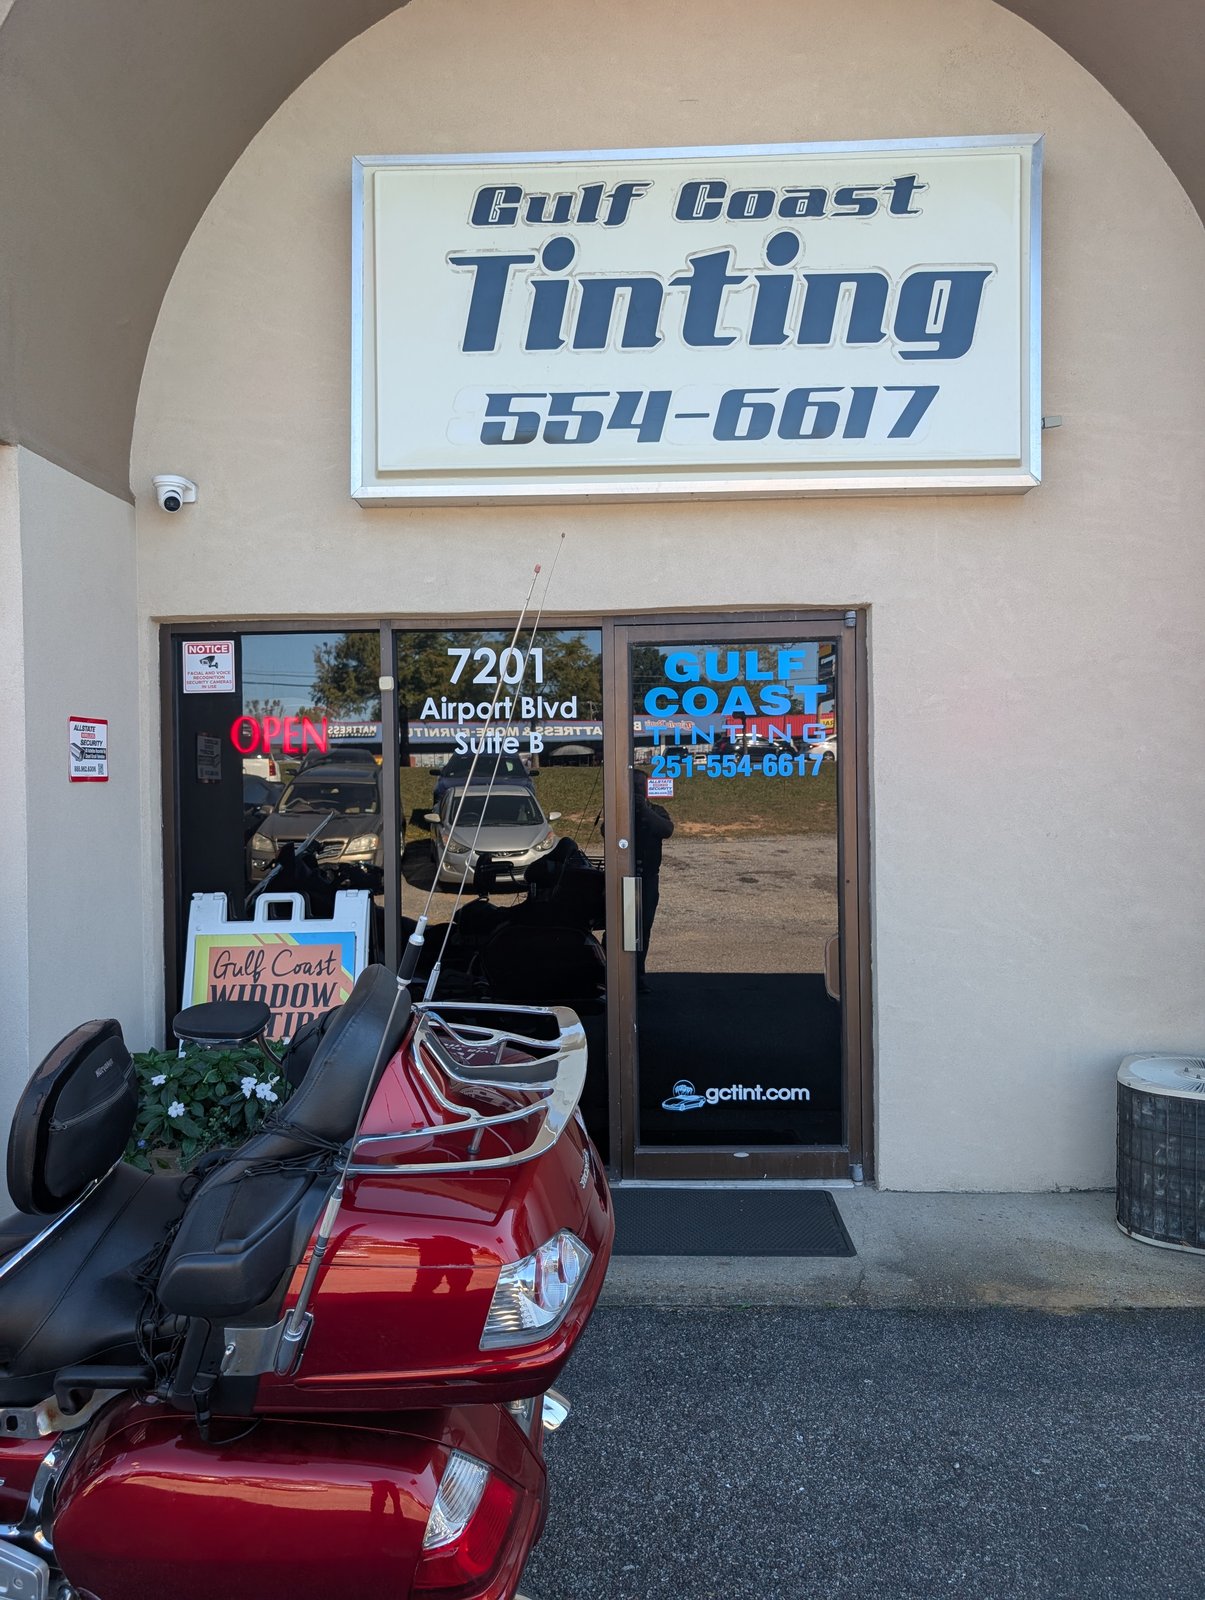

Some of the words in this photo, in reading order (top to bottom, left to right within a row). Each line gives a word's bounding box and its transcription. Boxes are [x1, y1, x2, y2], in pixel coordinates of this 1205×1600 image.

[468, 180, 654, 226] Gulf
[674, 174, 929, 221] Coast
[448, 232, 993, 361] Tinting
[479, 385, 940, 446] 554-6617
[188, 645, 228, 653] NOTICE
[447, 647, 544, 685] 7201
[664, 649, 807, 683] GULF
[420, 696, 512, 724] Airport
[521, 695, 578, 719] Blvd
[643, 684, 828, 718] COAST
[74, 724, 96, 732] ALLSTATE
[230, 716, 329, 754] OPEN
[645, 723, 827, 746] TINTING
[80, 739, 104, 747] SECURITY
[454, 732, 520, 755] Suite
[529, 732, 544, 754] B
[651, 753, 824, 778] 251-554-6617
[213, 949, 267, 984] Gulf
[271, 949, 337, 977] Coast
[209, 982, 338, 1008] WINDOW
[705, 1084, 811, 1105] gctint.com
